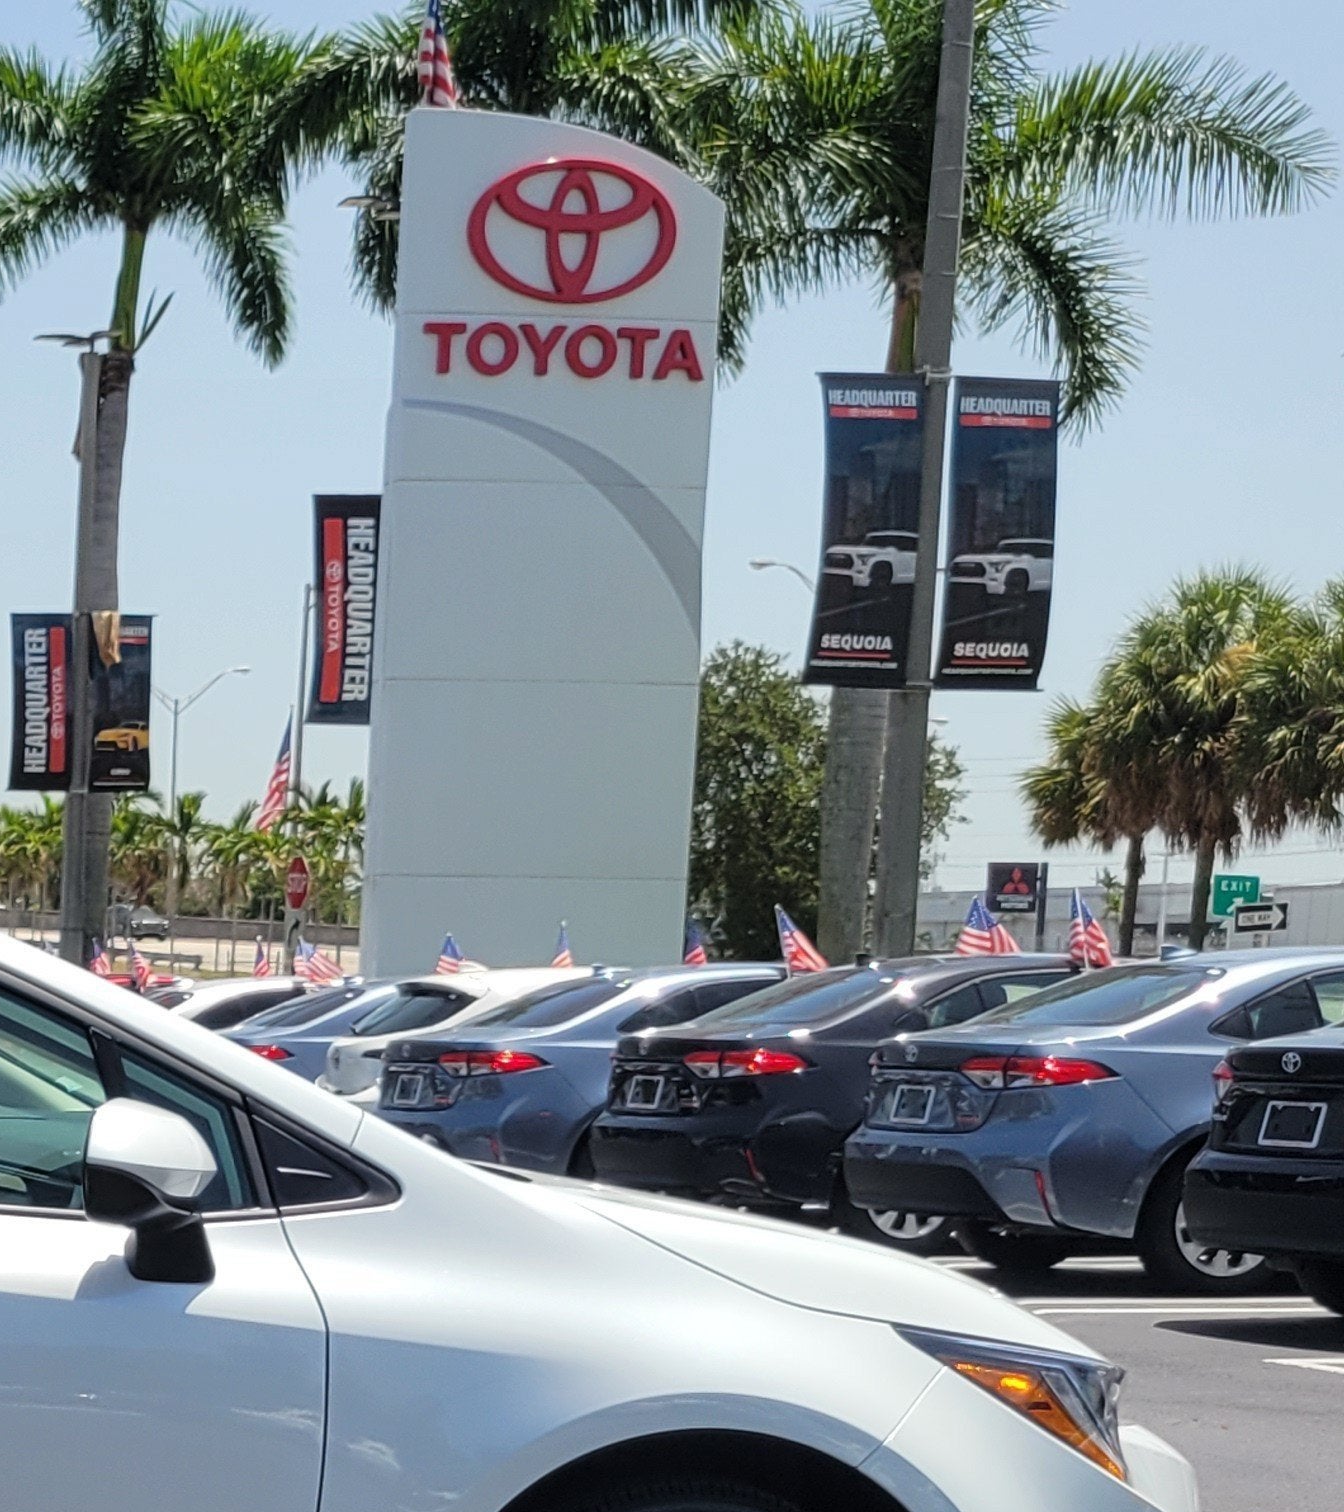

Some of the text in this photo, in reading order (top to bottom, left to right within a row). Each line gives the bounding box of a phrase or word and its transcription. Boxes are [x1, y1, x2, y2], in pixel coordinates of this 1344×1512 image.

[423, 322, 704, 382] TOYOTA
[828, 389, 917, 408] HEADQUARTER
[959, 397, 1052, 417] HEADQUARTER
[325, 585, 342, 654] TOYOTA
[340, 516, 376, 702] HEADQUARTER
[820, 634, 893, 651] SEQUOIA
[953, 642, 1029, 659] SEQUOIA
[23, 627, 48, 774] HEADQUARTER
[50, 666, 64, 722] TOYOTA
[1220, 880, 1252, 893] EXIT
